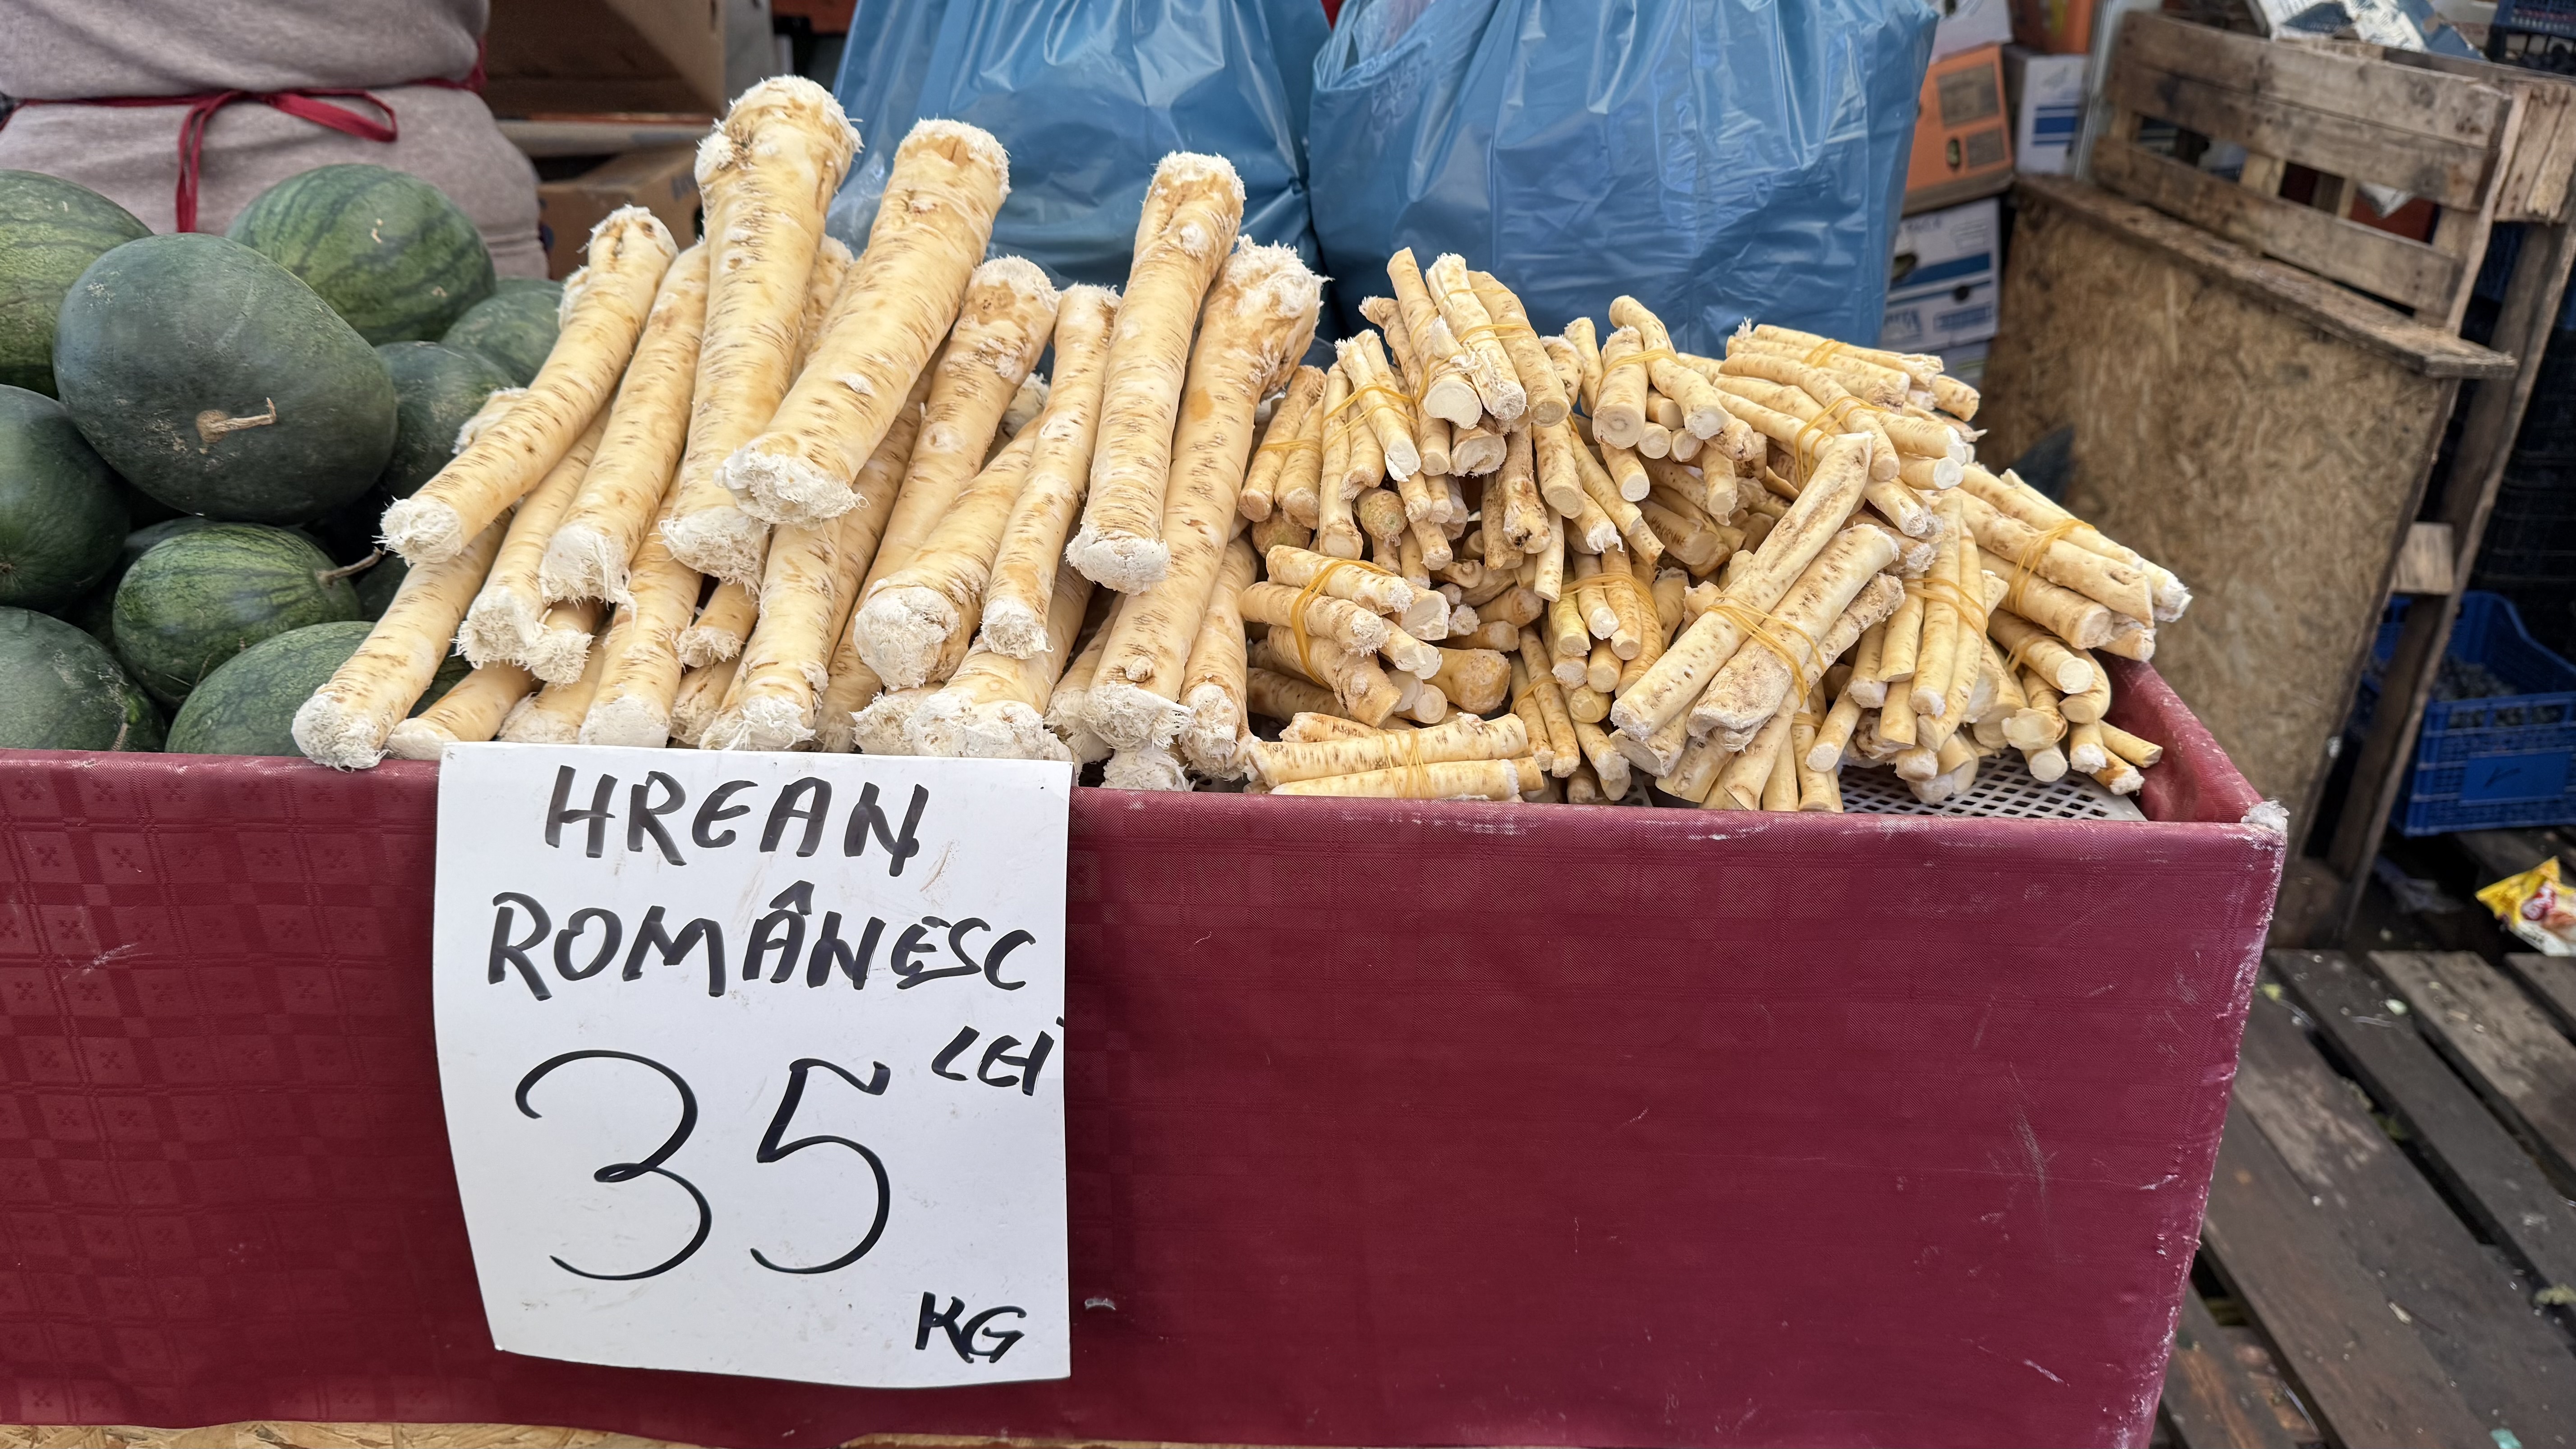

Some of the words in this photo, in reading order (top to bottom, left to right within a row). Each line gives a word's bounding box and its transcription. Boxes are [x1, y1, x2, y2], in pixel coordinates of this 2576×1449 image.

[545, 764, 929, 878] HREAN
[488, 879, 1036, 1002] ROMÂNESC
[515, 1049, 891, 1282] 35
[915, 1291, 1027, 1365] KG
